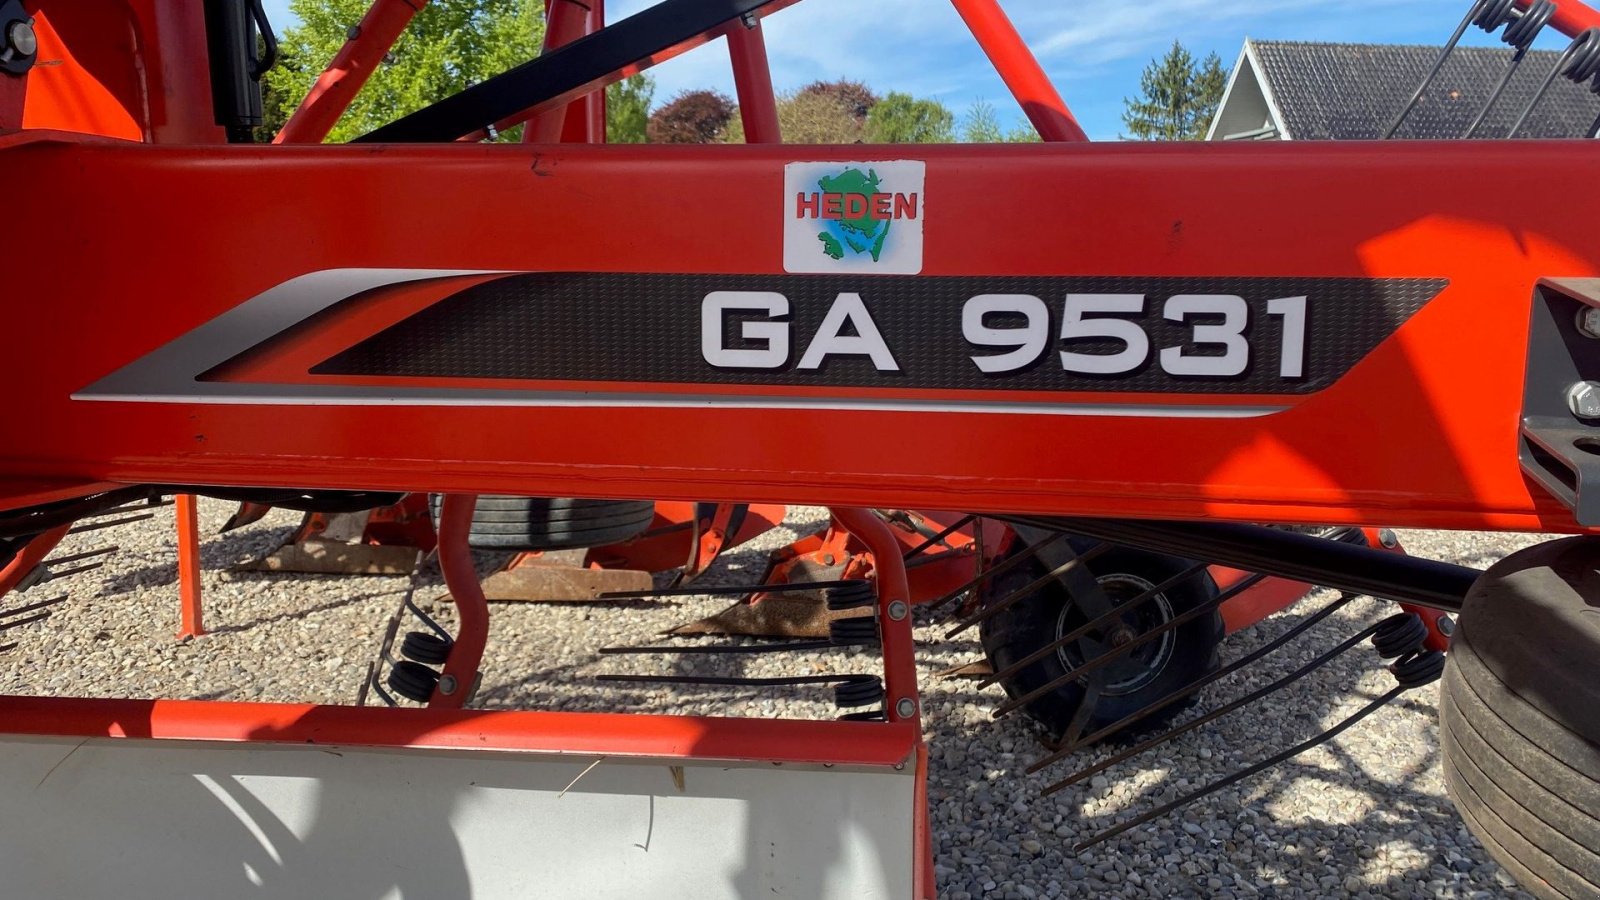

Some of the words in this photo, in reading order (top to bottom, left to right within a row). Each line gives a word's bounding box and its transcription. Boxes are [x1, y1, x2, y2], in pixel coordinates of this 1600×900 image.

[796, 192, 917, 219] HEDEN
[701, 291, 901, 371] GA
[961, 293, 1309, 379] 9531
